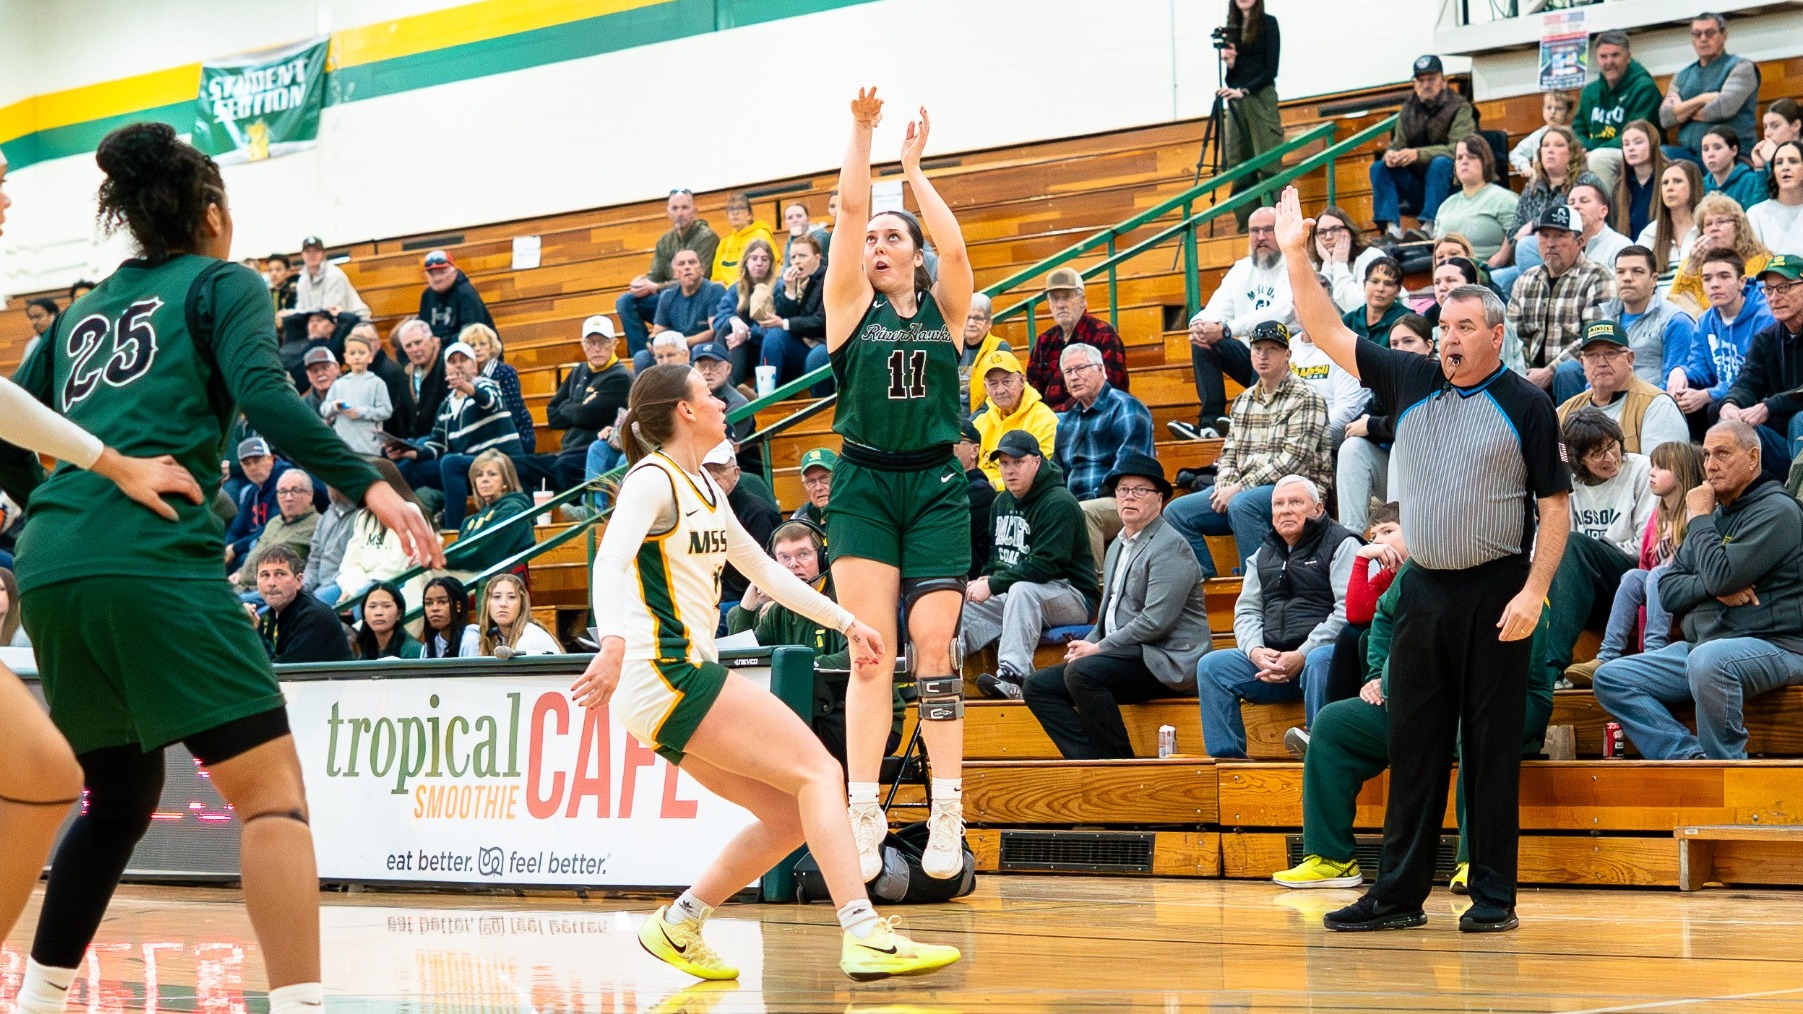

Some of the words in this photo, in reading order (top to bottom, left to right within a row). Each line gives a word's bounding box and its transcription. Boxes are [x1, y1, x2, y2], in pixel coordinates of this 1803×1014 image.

[208, 58, 307, 101] STUDENT
[213, 83, 307, 124] SECTION
[62, 296, 165, 413] 25
[888, 350, 927, 399] 11
[326, 692, 521, 795] tropical
[414, 784, 520, 820] SMOOTHIE
[386, 850, 413, 872] eat
[418, 849, 474, 873] better.
[509, 851, 543, 874] feel
[548, 852, 608, 875] better.
